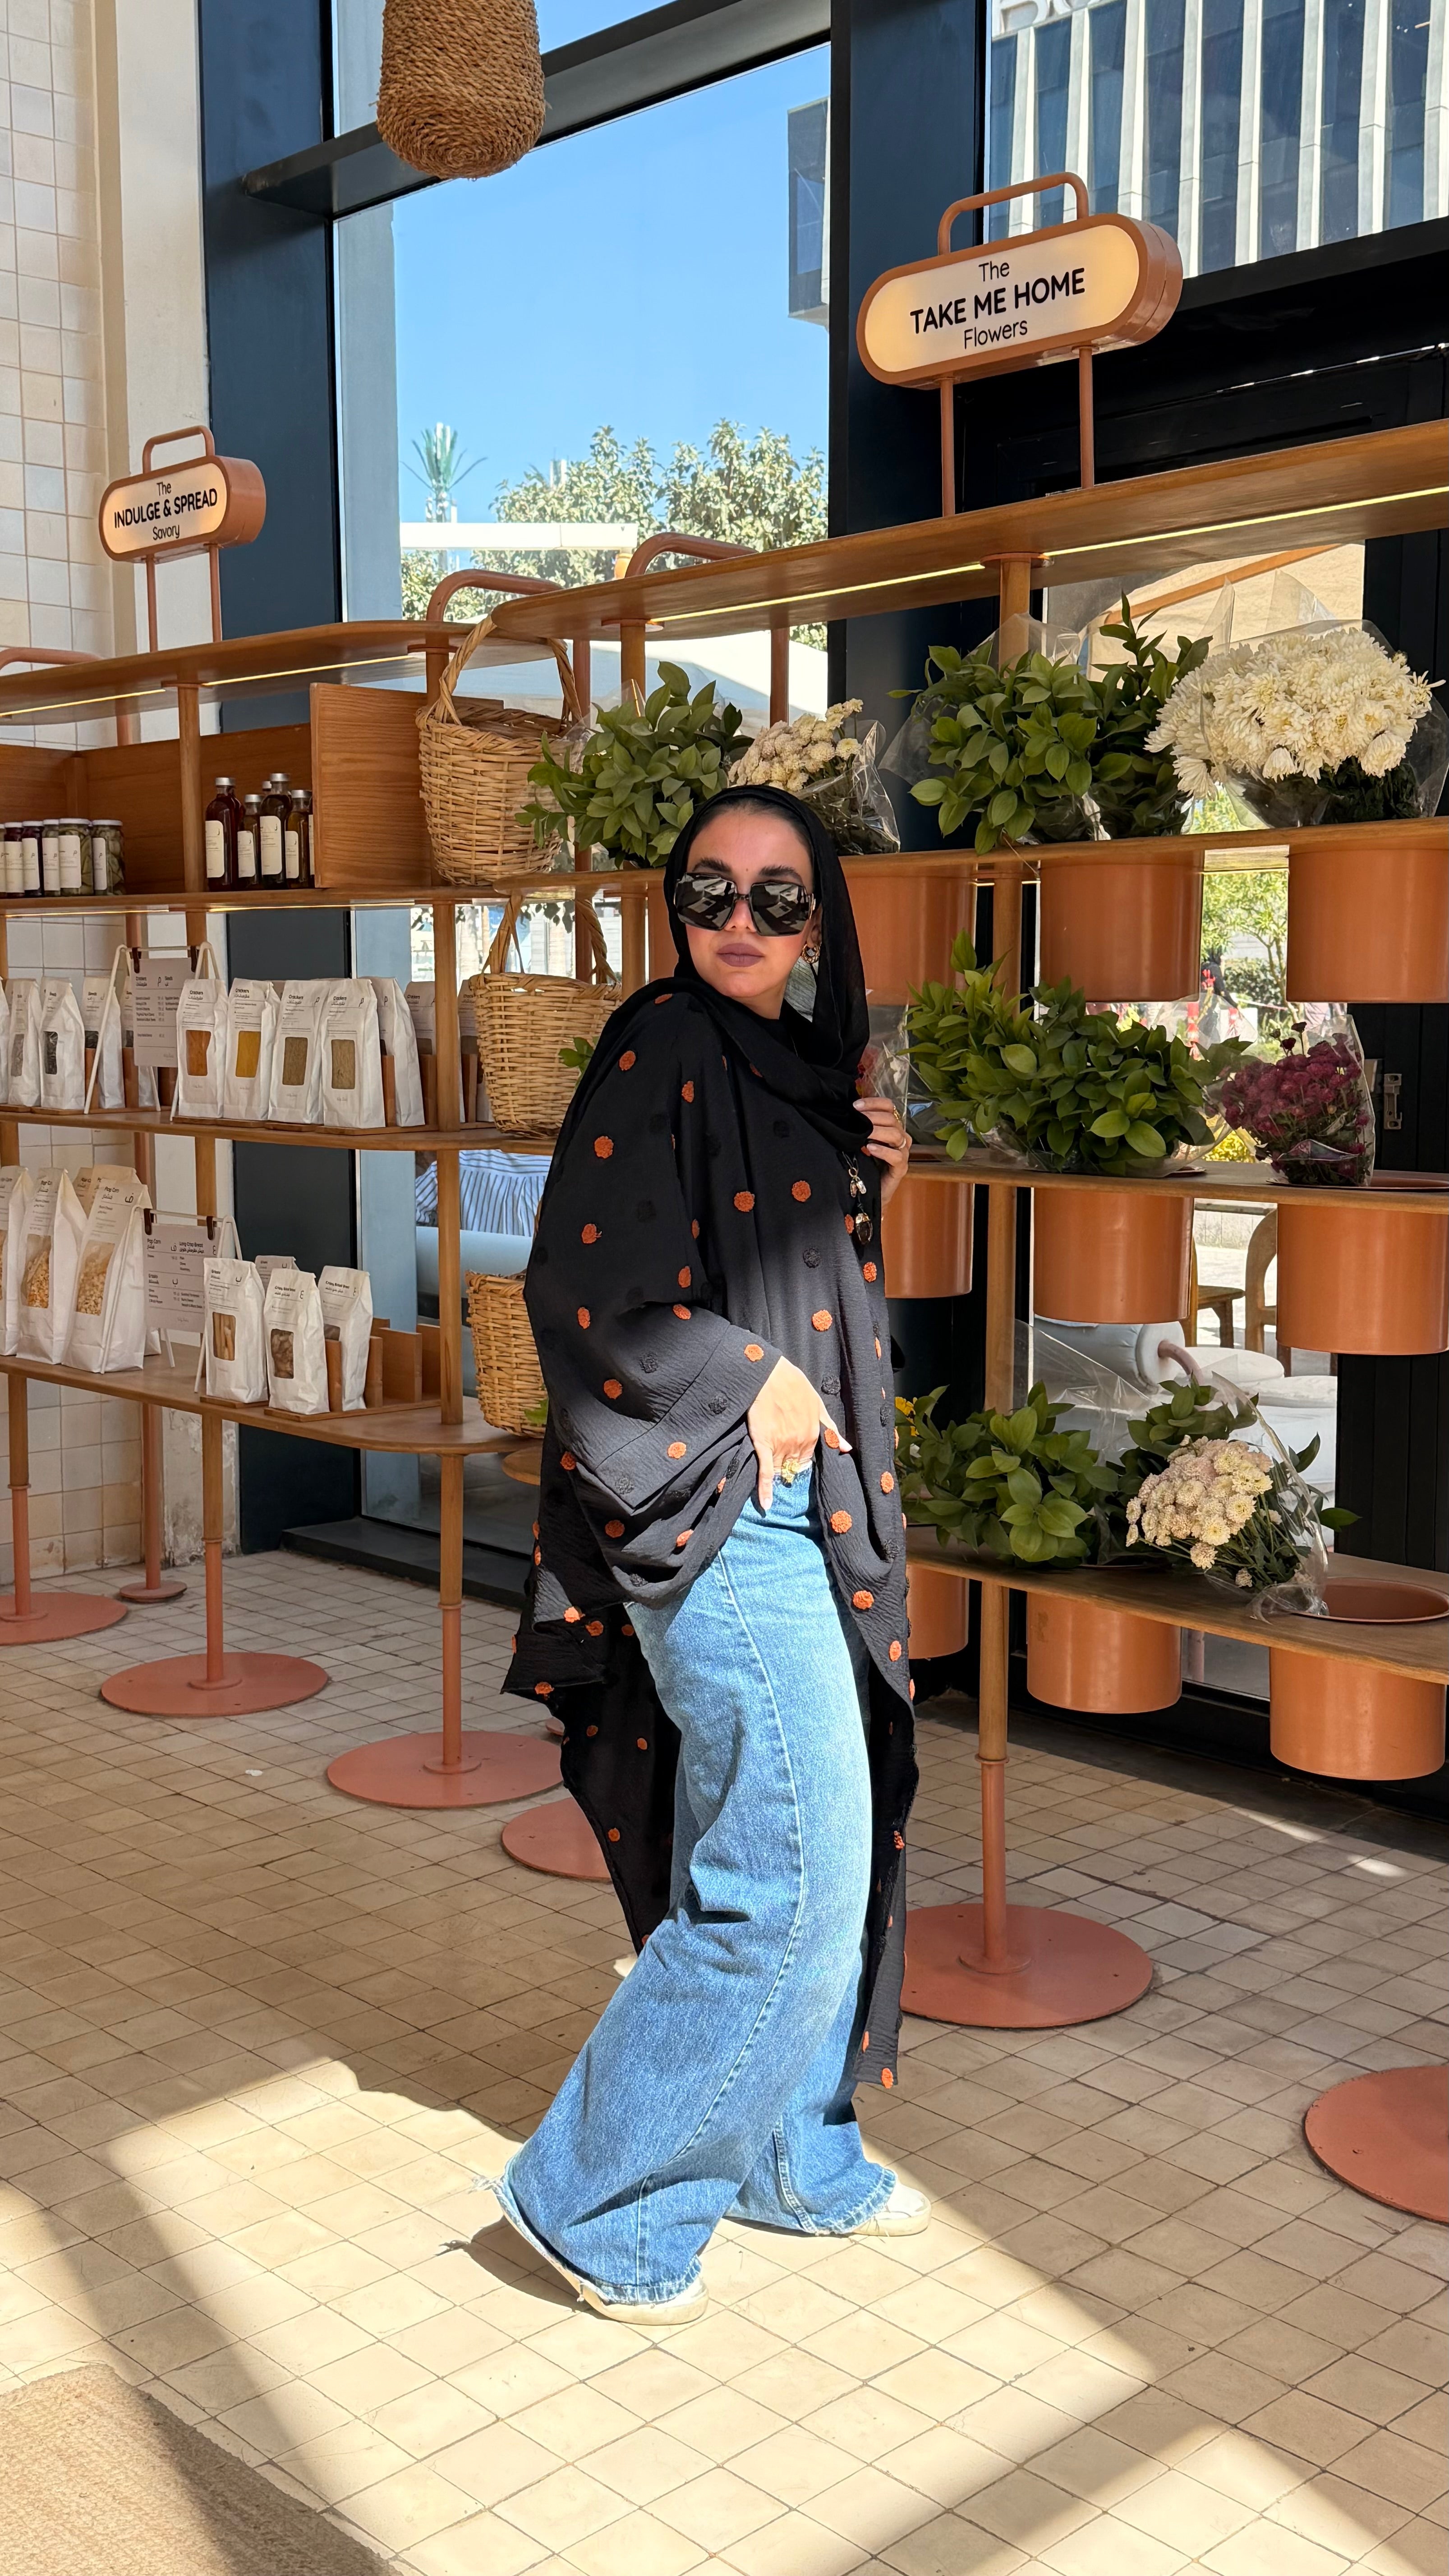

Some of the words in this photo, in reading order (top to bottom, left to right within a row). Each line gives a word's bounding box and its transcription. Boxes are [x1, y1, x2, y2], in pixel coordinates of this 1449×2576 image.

[978, 261, 1010, 282] The
[910, 298, 966, 334] TAKE
[974, 287, 1007, 319] ME
[1014, 267, 1085, 309] HOME
[964, 320, 1028, 350] Flowers
[156, 482, 171, 496] The
[114, 501, 161, 528] INDULGE
[163, 499, 171, 517] &
[174, 488, 217, 515] SPREAD
[152, 524, 180, 540] Savory
